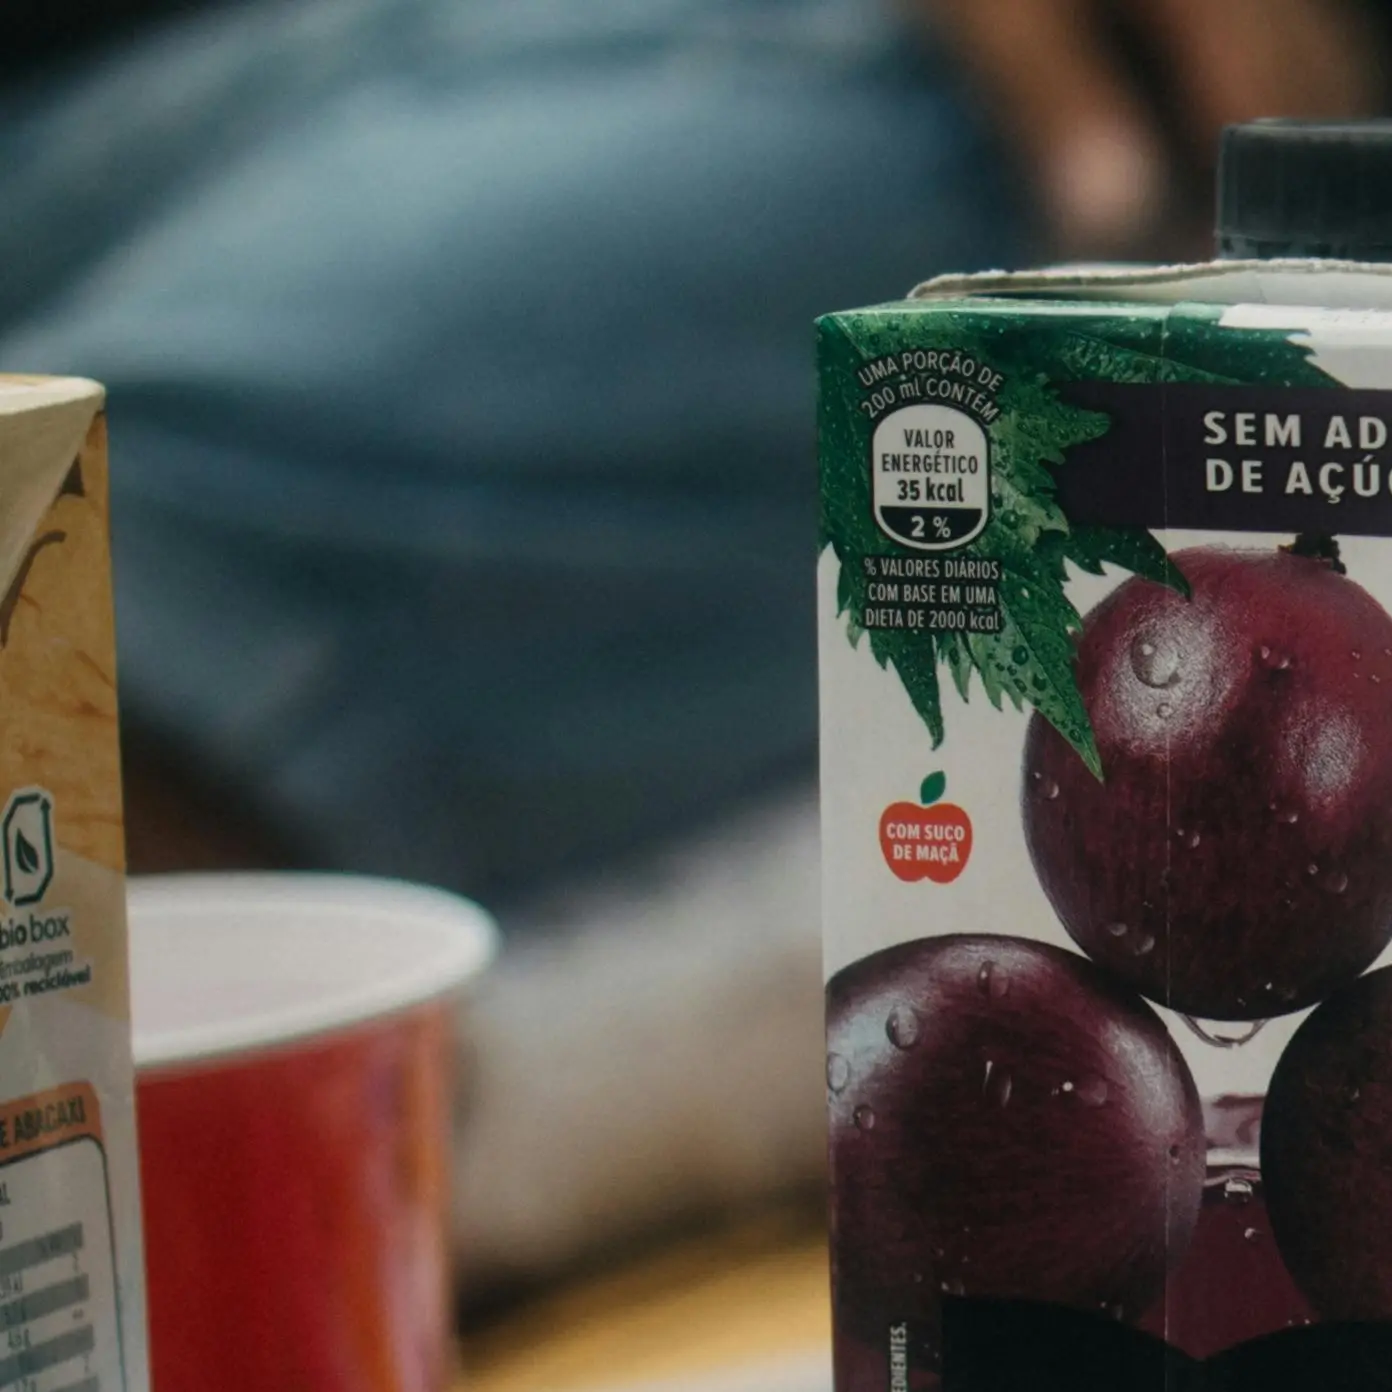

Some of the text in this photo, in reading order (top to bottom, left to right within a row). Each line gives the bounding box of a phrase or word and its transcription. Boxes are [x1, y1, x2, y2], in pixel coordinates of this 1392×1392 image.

[858, 351, 1003, 392] UMA PORÇÃO DE
[861, 377, 999, 422] 200 ml CONTÉM
[904, 428, 955, 449] VALOR
[1203, 411, 1301, 447] SEM
[881, 451, 978, 474] ENERGÉTICO
[1205, 458, 1263, 493] DE
[897, 477, 964, 502] 35 kcal
[911, 516, 925, 537] 2
[880, 558, 940, 578] VALORES
[945, 556, 999, 579] DIÁRIOS
[868, 583, 996, 604] COM BASE EM UMA
[865, 608, 999, 631] DIETA DE 2000 kcal
[886, 822, 965, 841] COM SUCO
[893, 842, 959, 865] DE MAÇÃ
[29, 913, 70, 943] box
